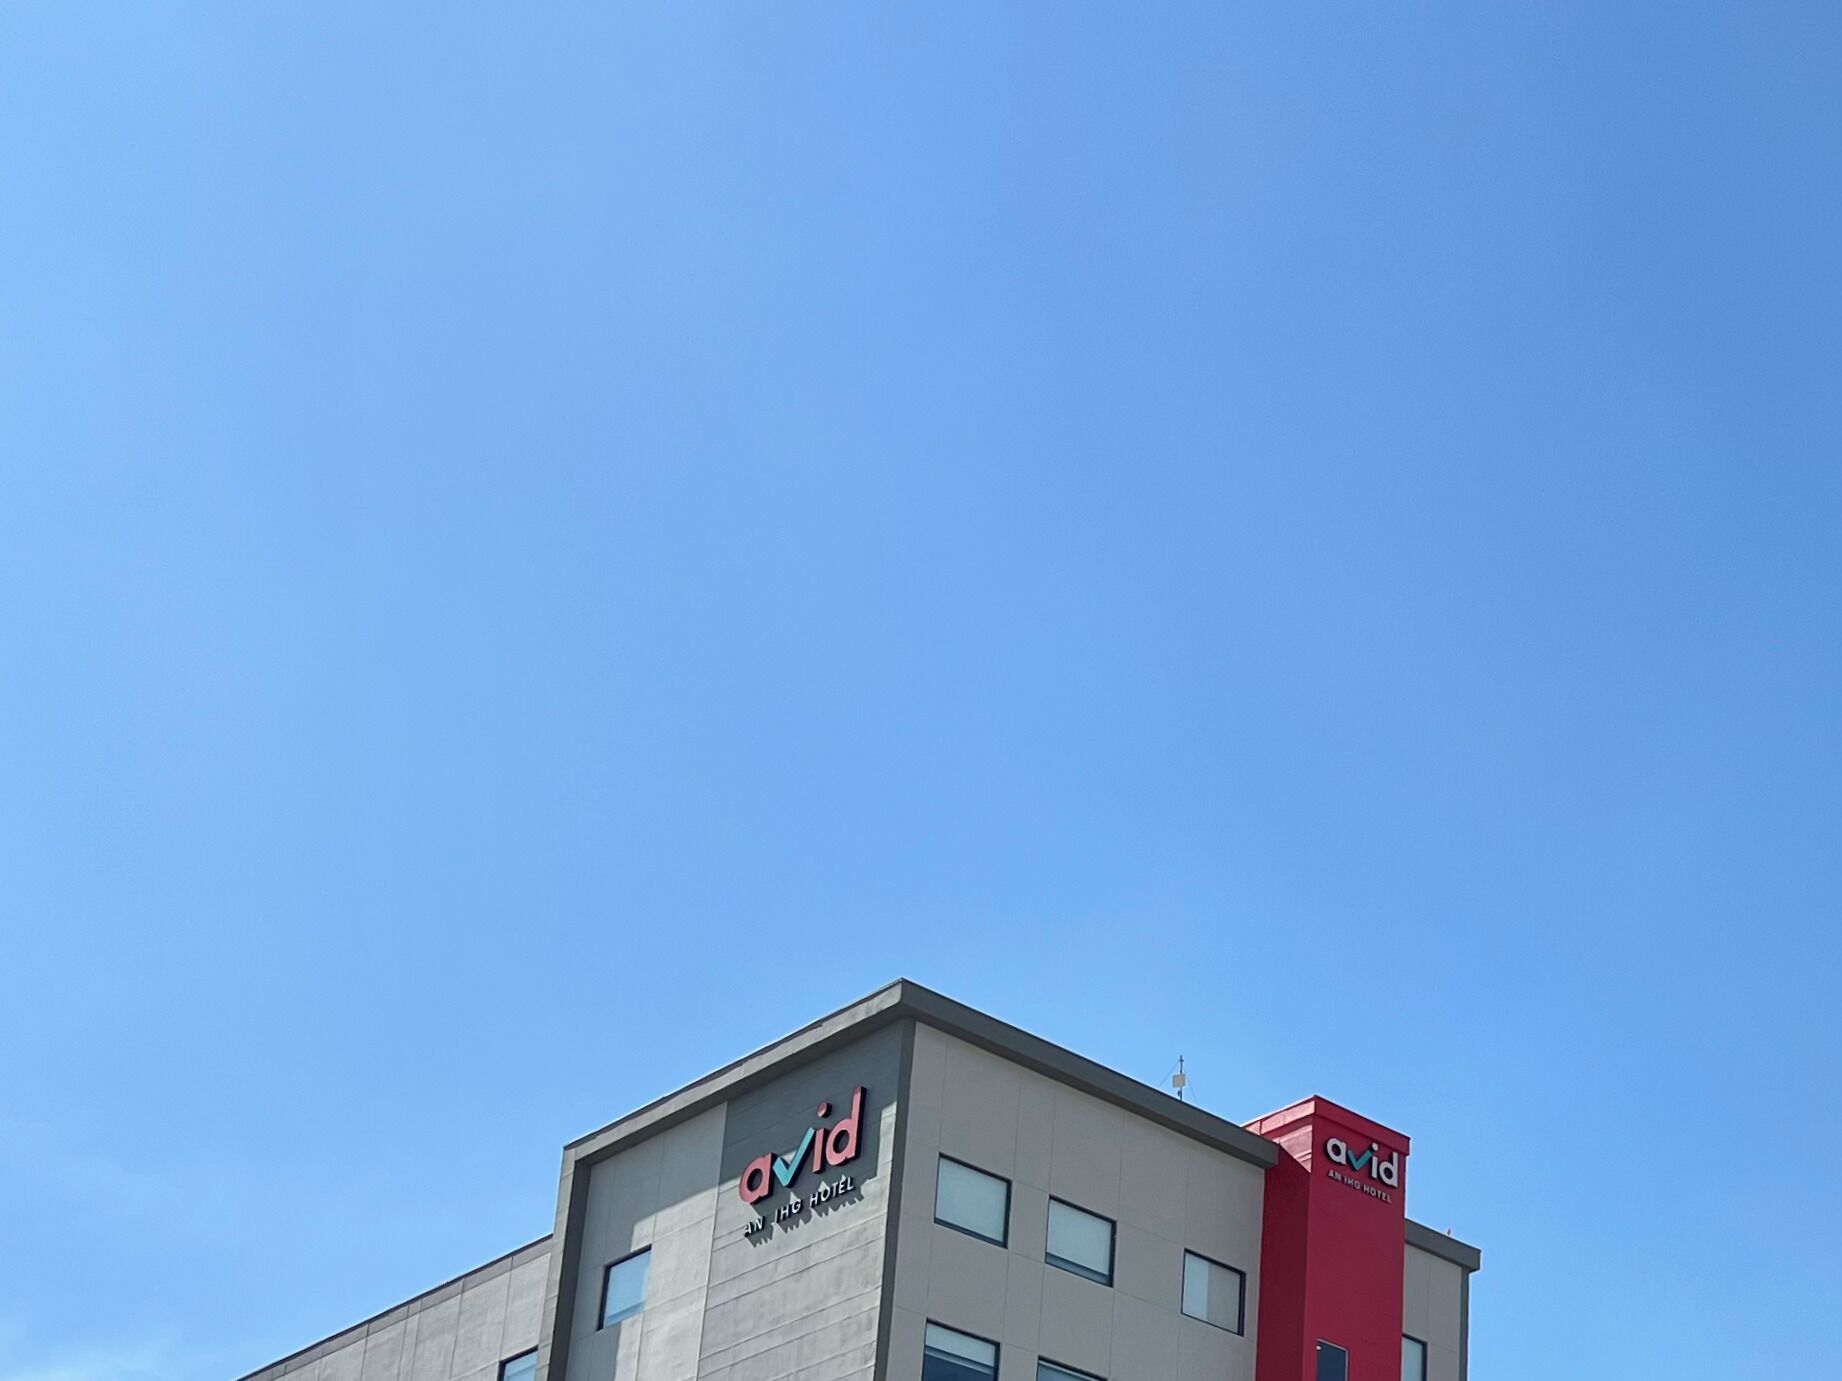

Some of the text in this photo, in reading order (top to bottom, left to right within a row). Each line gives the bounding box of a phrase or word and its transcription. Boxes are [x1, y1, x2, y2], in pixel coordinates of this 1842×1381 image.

[739, 1086, 867, 1205] avid
[1326, 1137, 1399, 1188] avid
[744, 1176, 856, 1237] AN IHG HOTEL
[1328, 1169, 1342, 1182] AN
[1363, 1184, 1392, 1203] HOTEL
